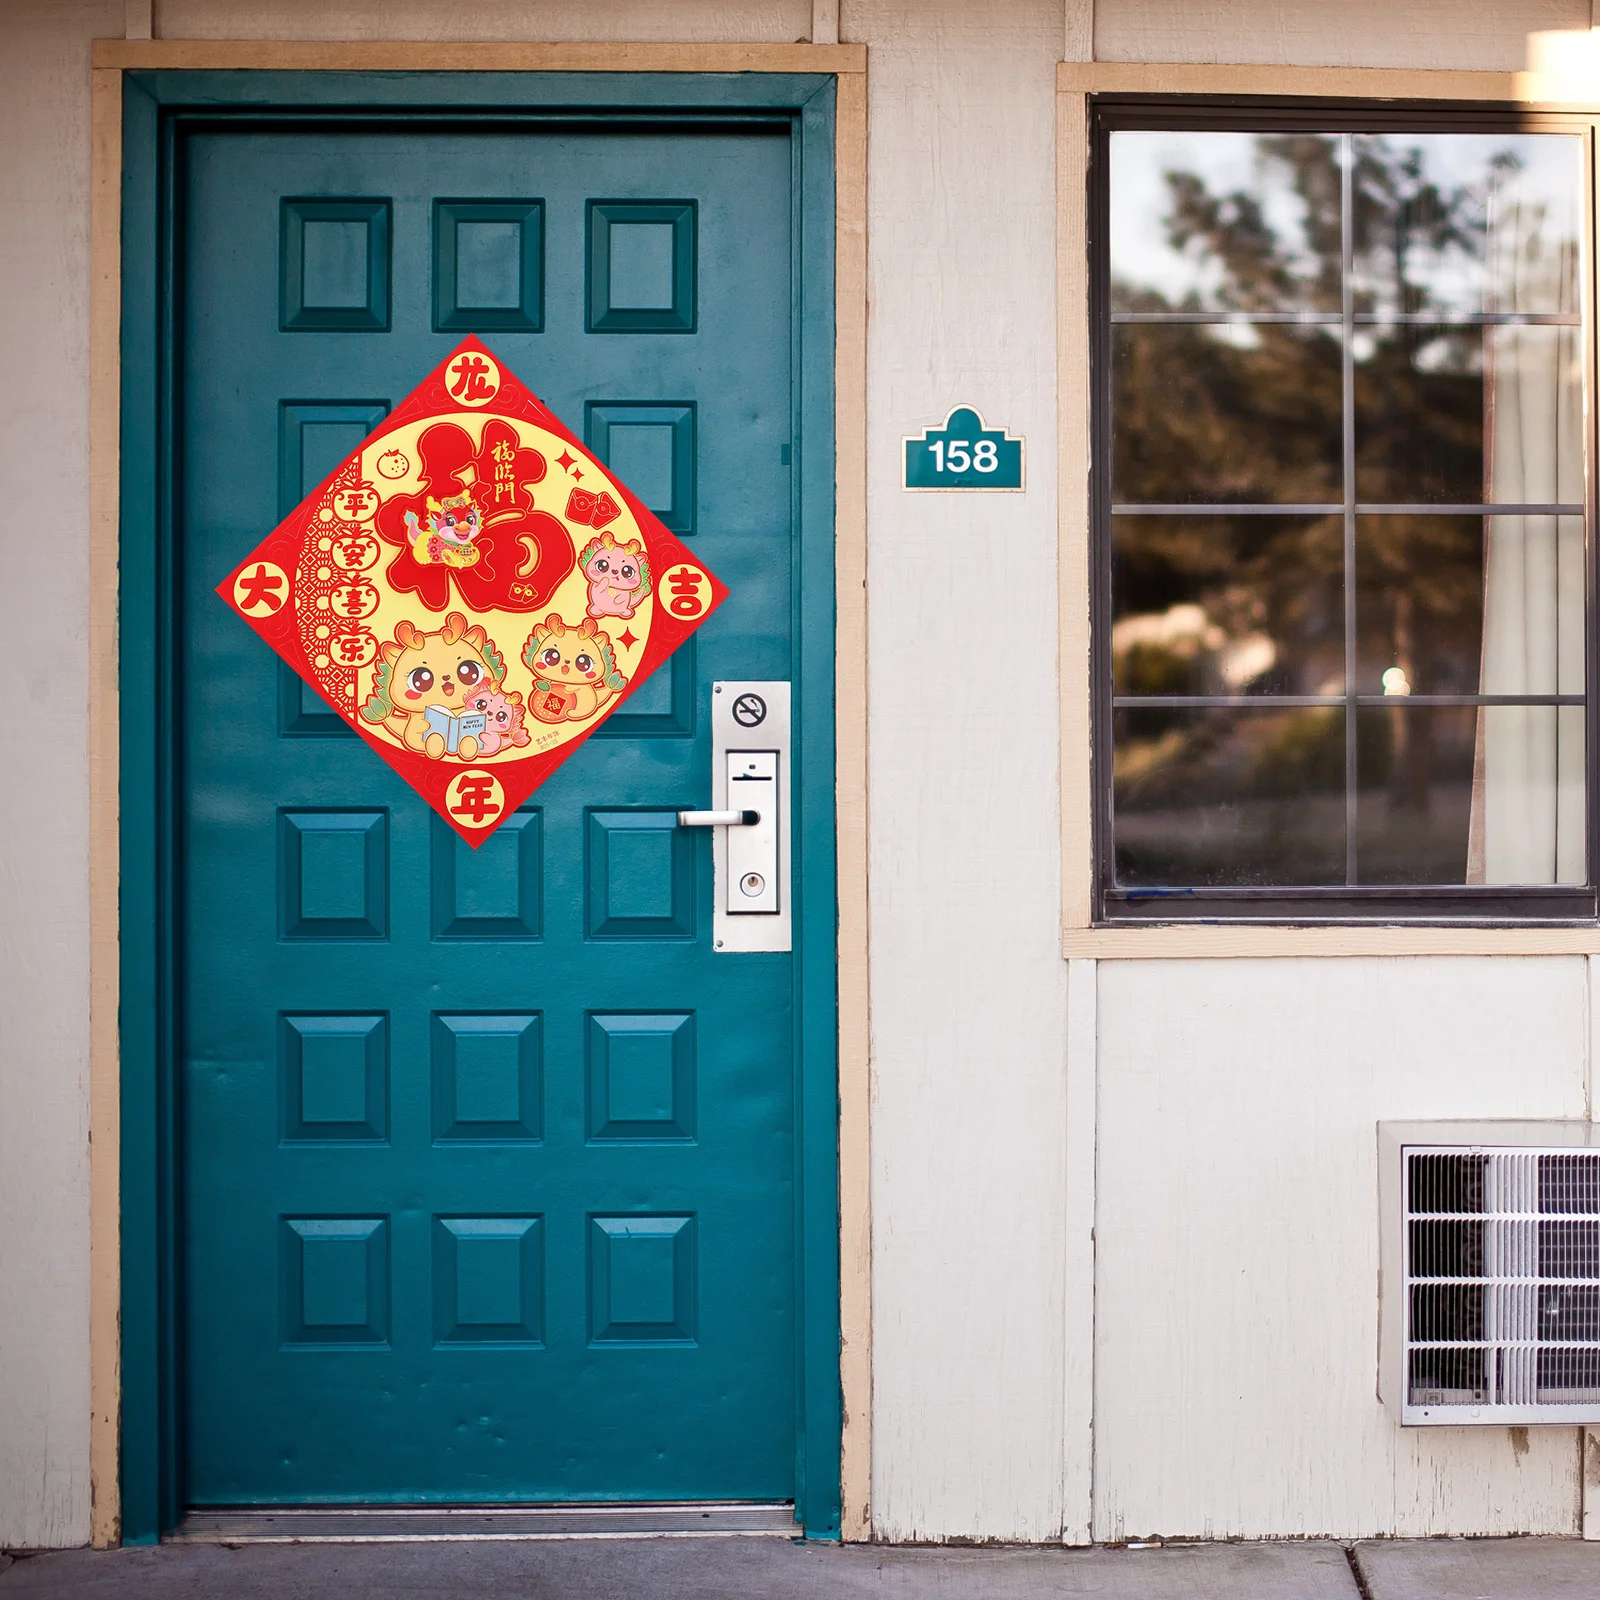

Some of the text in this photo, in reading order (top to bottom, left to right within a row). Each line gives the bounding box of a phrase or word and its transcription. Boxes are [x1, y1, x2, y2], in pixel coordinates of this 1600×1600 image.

[451, 356, 495, 401] 龙
[928, 440, 998, 473] 158
[239, 565, 283, 613] 大
[668, 567, 702, 617] 吉
[450, 775, 500, 822] 年
